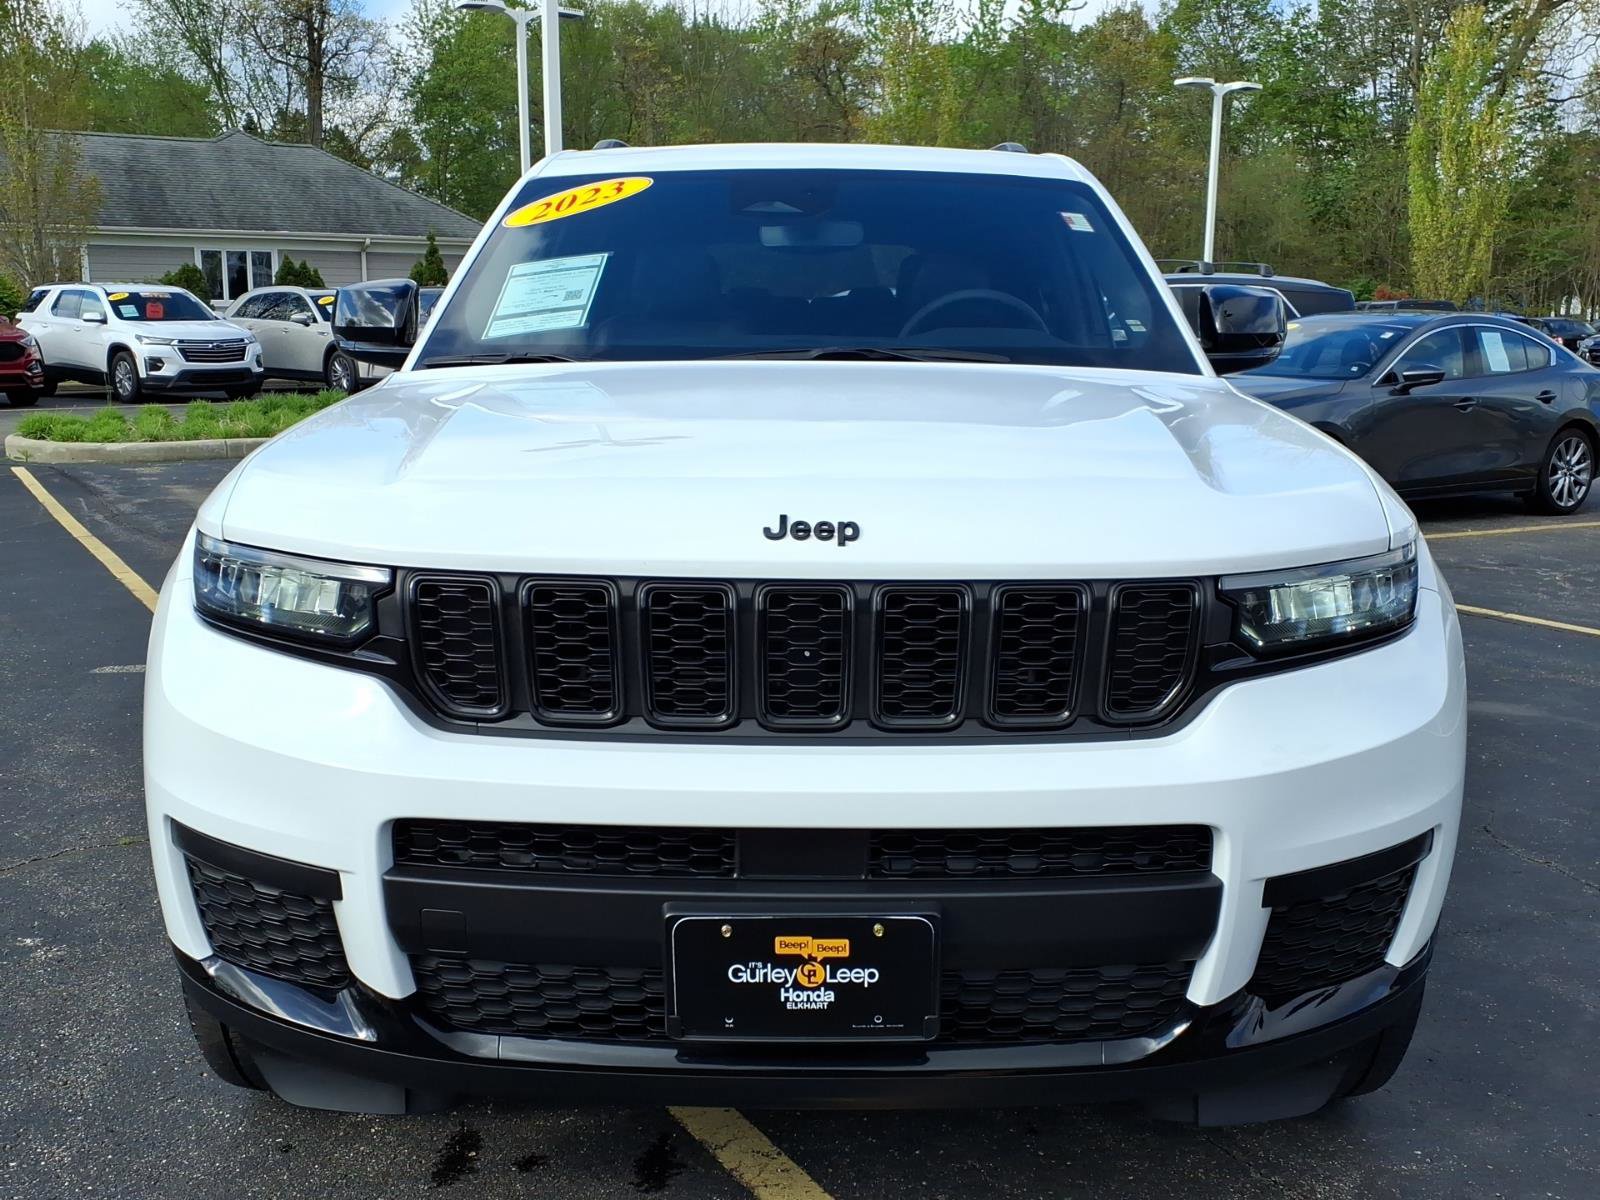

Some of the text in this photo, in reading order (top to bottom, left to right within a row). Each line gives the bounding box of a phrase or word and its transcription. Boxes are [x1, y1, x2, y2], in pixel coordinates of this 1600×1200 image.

[529, 181, 626, 222] 2023
[762, 514, 861, 547] Jeep
[779, 940, 847, 955] Beep! Beep!
[748, 961, 763, 969] IT'S
[727, 963, 798, 988] Gurley
[825, 964, 880, 988] Leep
[780, 987, 835, 1002] Honda
[786, 1002, 829, 1010] ELKHART
